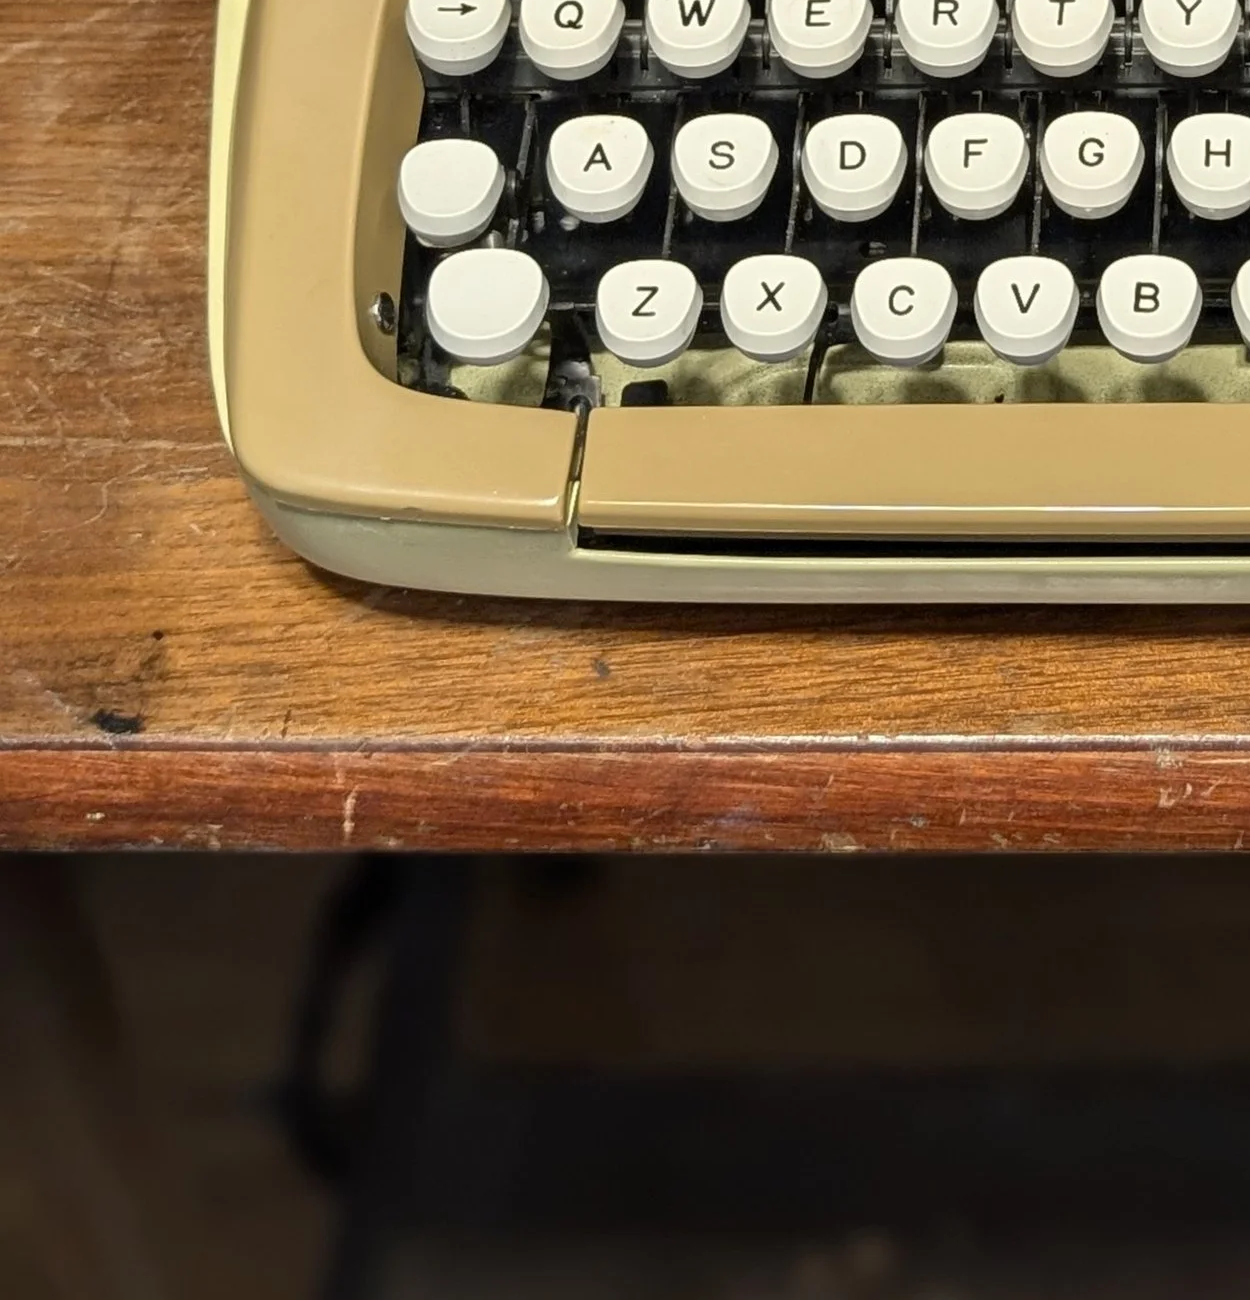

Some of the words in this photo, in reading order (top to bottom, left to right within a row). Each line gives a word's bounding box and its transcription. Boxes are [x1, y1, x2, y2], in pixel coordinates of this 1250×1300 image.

[553, 0, 584, 30] Q
[583, 142, 612, 173] A
[708, 140, 735, 170] S
[839, 140, 867, 171] D
[963, 138, 989, 169] F
[1078, 137, 1105, 168] G
[1204, 138, 1232, 168] H
[631, 285, 659, 317] Z
[756, 281, 785, 312] X
[888, 284, 915, 317] C
[1010, 283, 1041, 314] V
[1133, 281, 1160, 314] B
